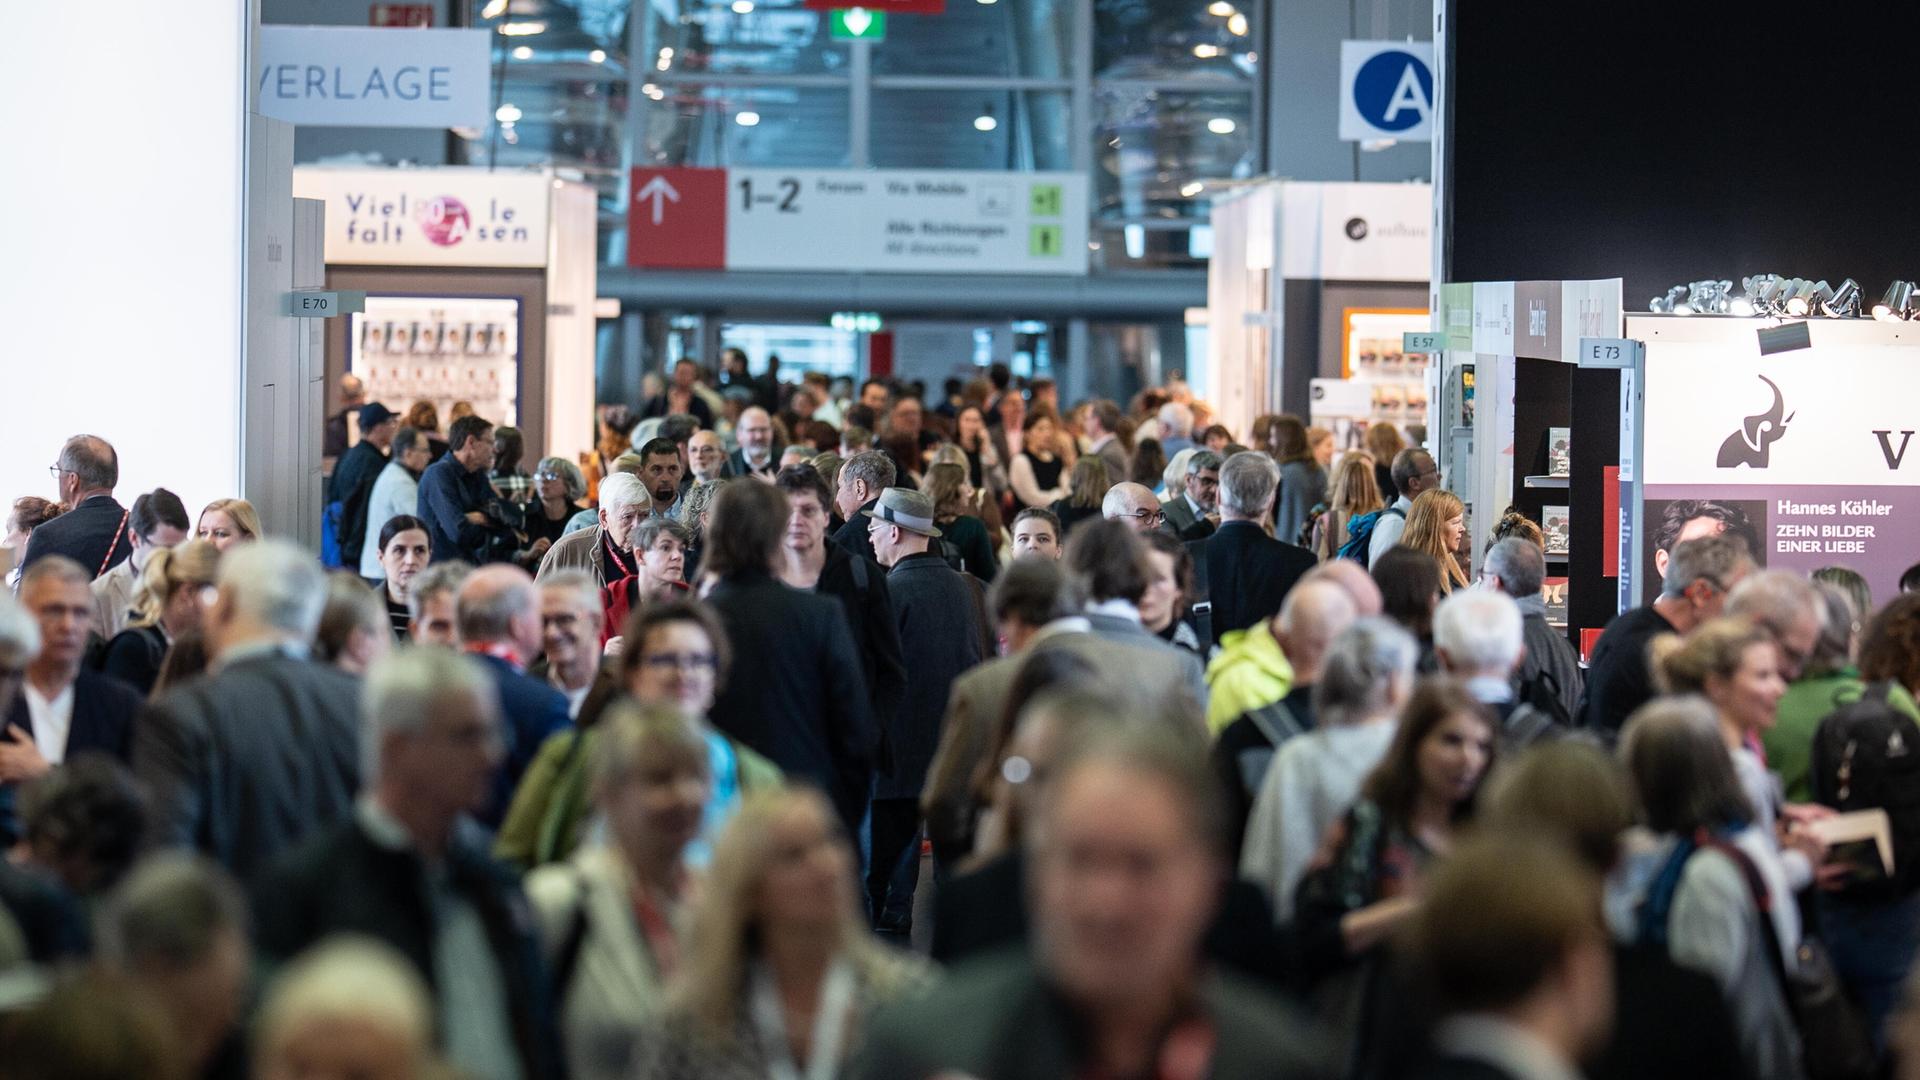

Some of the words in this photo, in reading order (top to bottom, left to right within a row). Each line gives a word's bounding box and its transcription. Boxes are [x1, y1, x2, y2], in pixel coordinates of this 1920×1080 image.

[346, 194, 406, 216] Viel
[347, 220, 404, 243] falt
[478, 227, 528, 242] sen
[303, 299, 311, 310] E
[312, 299, 328, 310] 70
[1412, 337, 1419, 347] E
[1422, 337, 1434, 347] 57
[1593, 346, 1601, 359] E
[1605, 347, 1620, 360] 73
[1872, 430, 1916, 470] V
[1777, 500, 1837, 515] Hannes
[1840, 500, 1893, 516] Köhler
[1776, 525, 1818, 537] ZEHN
[1821, 525, 1876, 538] BILDER
[1776, 541, 1822, 553] EINER
[1825, 541, 1866, 553] LIEBE
